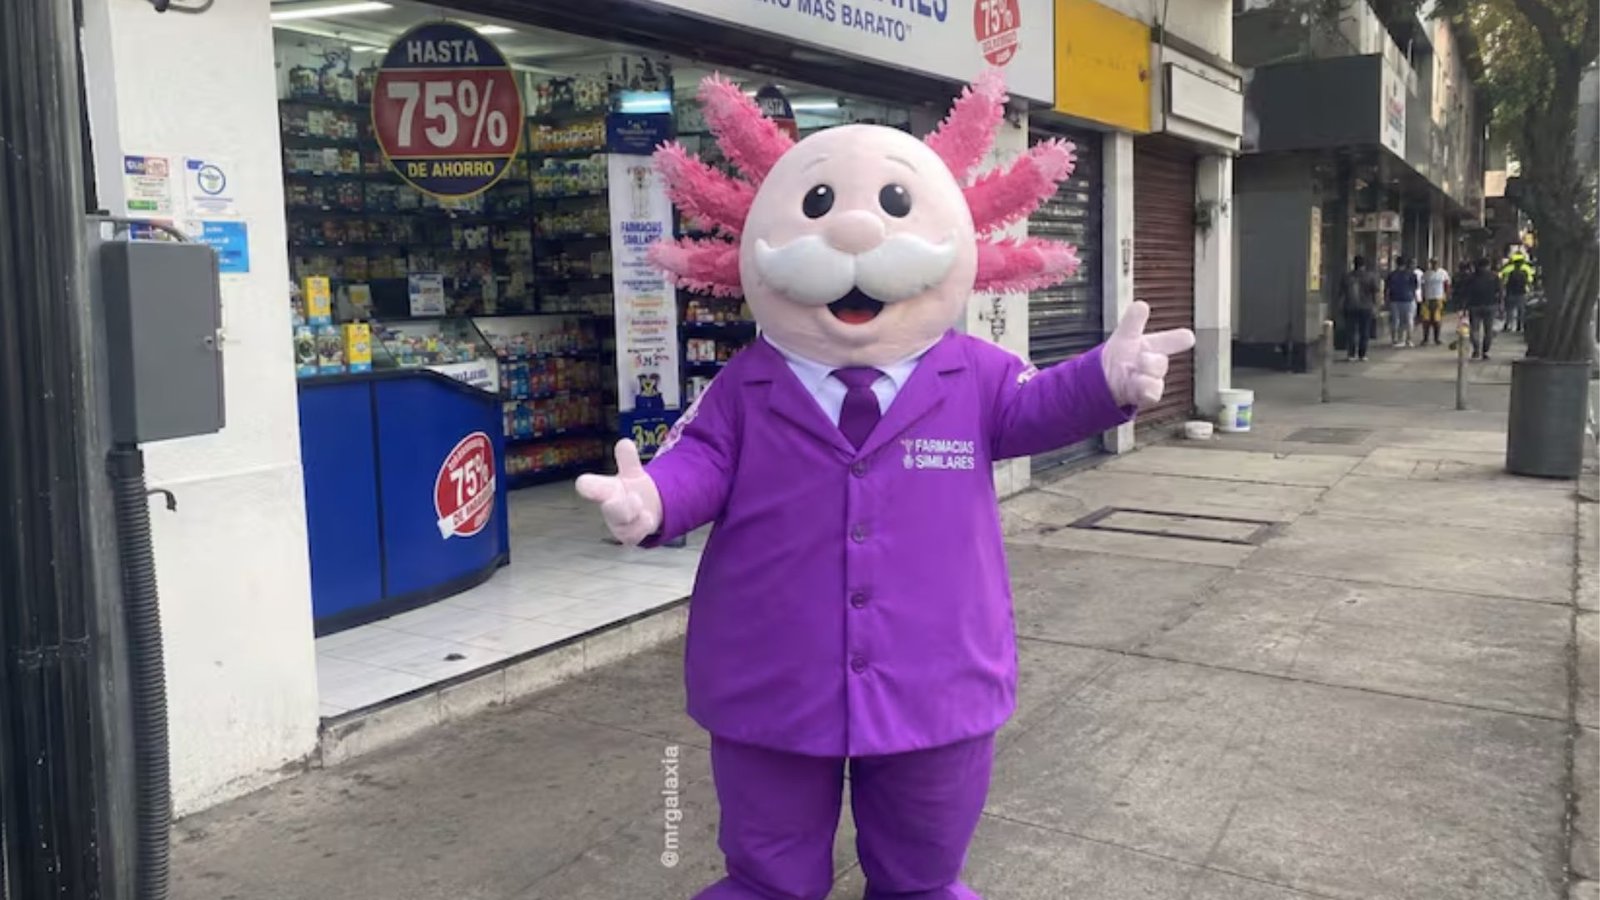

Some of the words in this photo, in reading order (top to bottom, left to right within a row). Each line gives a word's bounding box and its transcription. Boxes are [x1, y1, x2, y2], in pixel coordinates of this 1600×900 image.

[980, 0, 1013, 36] 75%
[407, 40, 479, 63] HASTA
[387, 79, 508, 148] 75%
[408, 163, 428, 177] DE
[432, 161, 495, 176] AHORRO
[915, 439, 975, 454] FARMACIAS
[915, 454, 975, 470] SIMILARES
[450, 453, 489, 507] 75%
